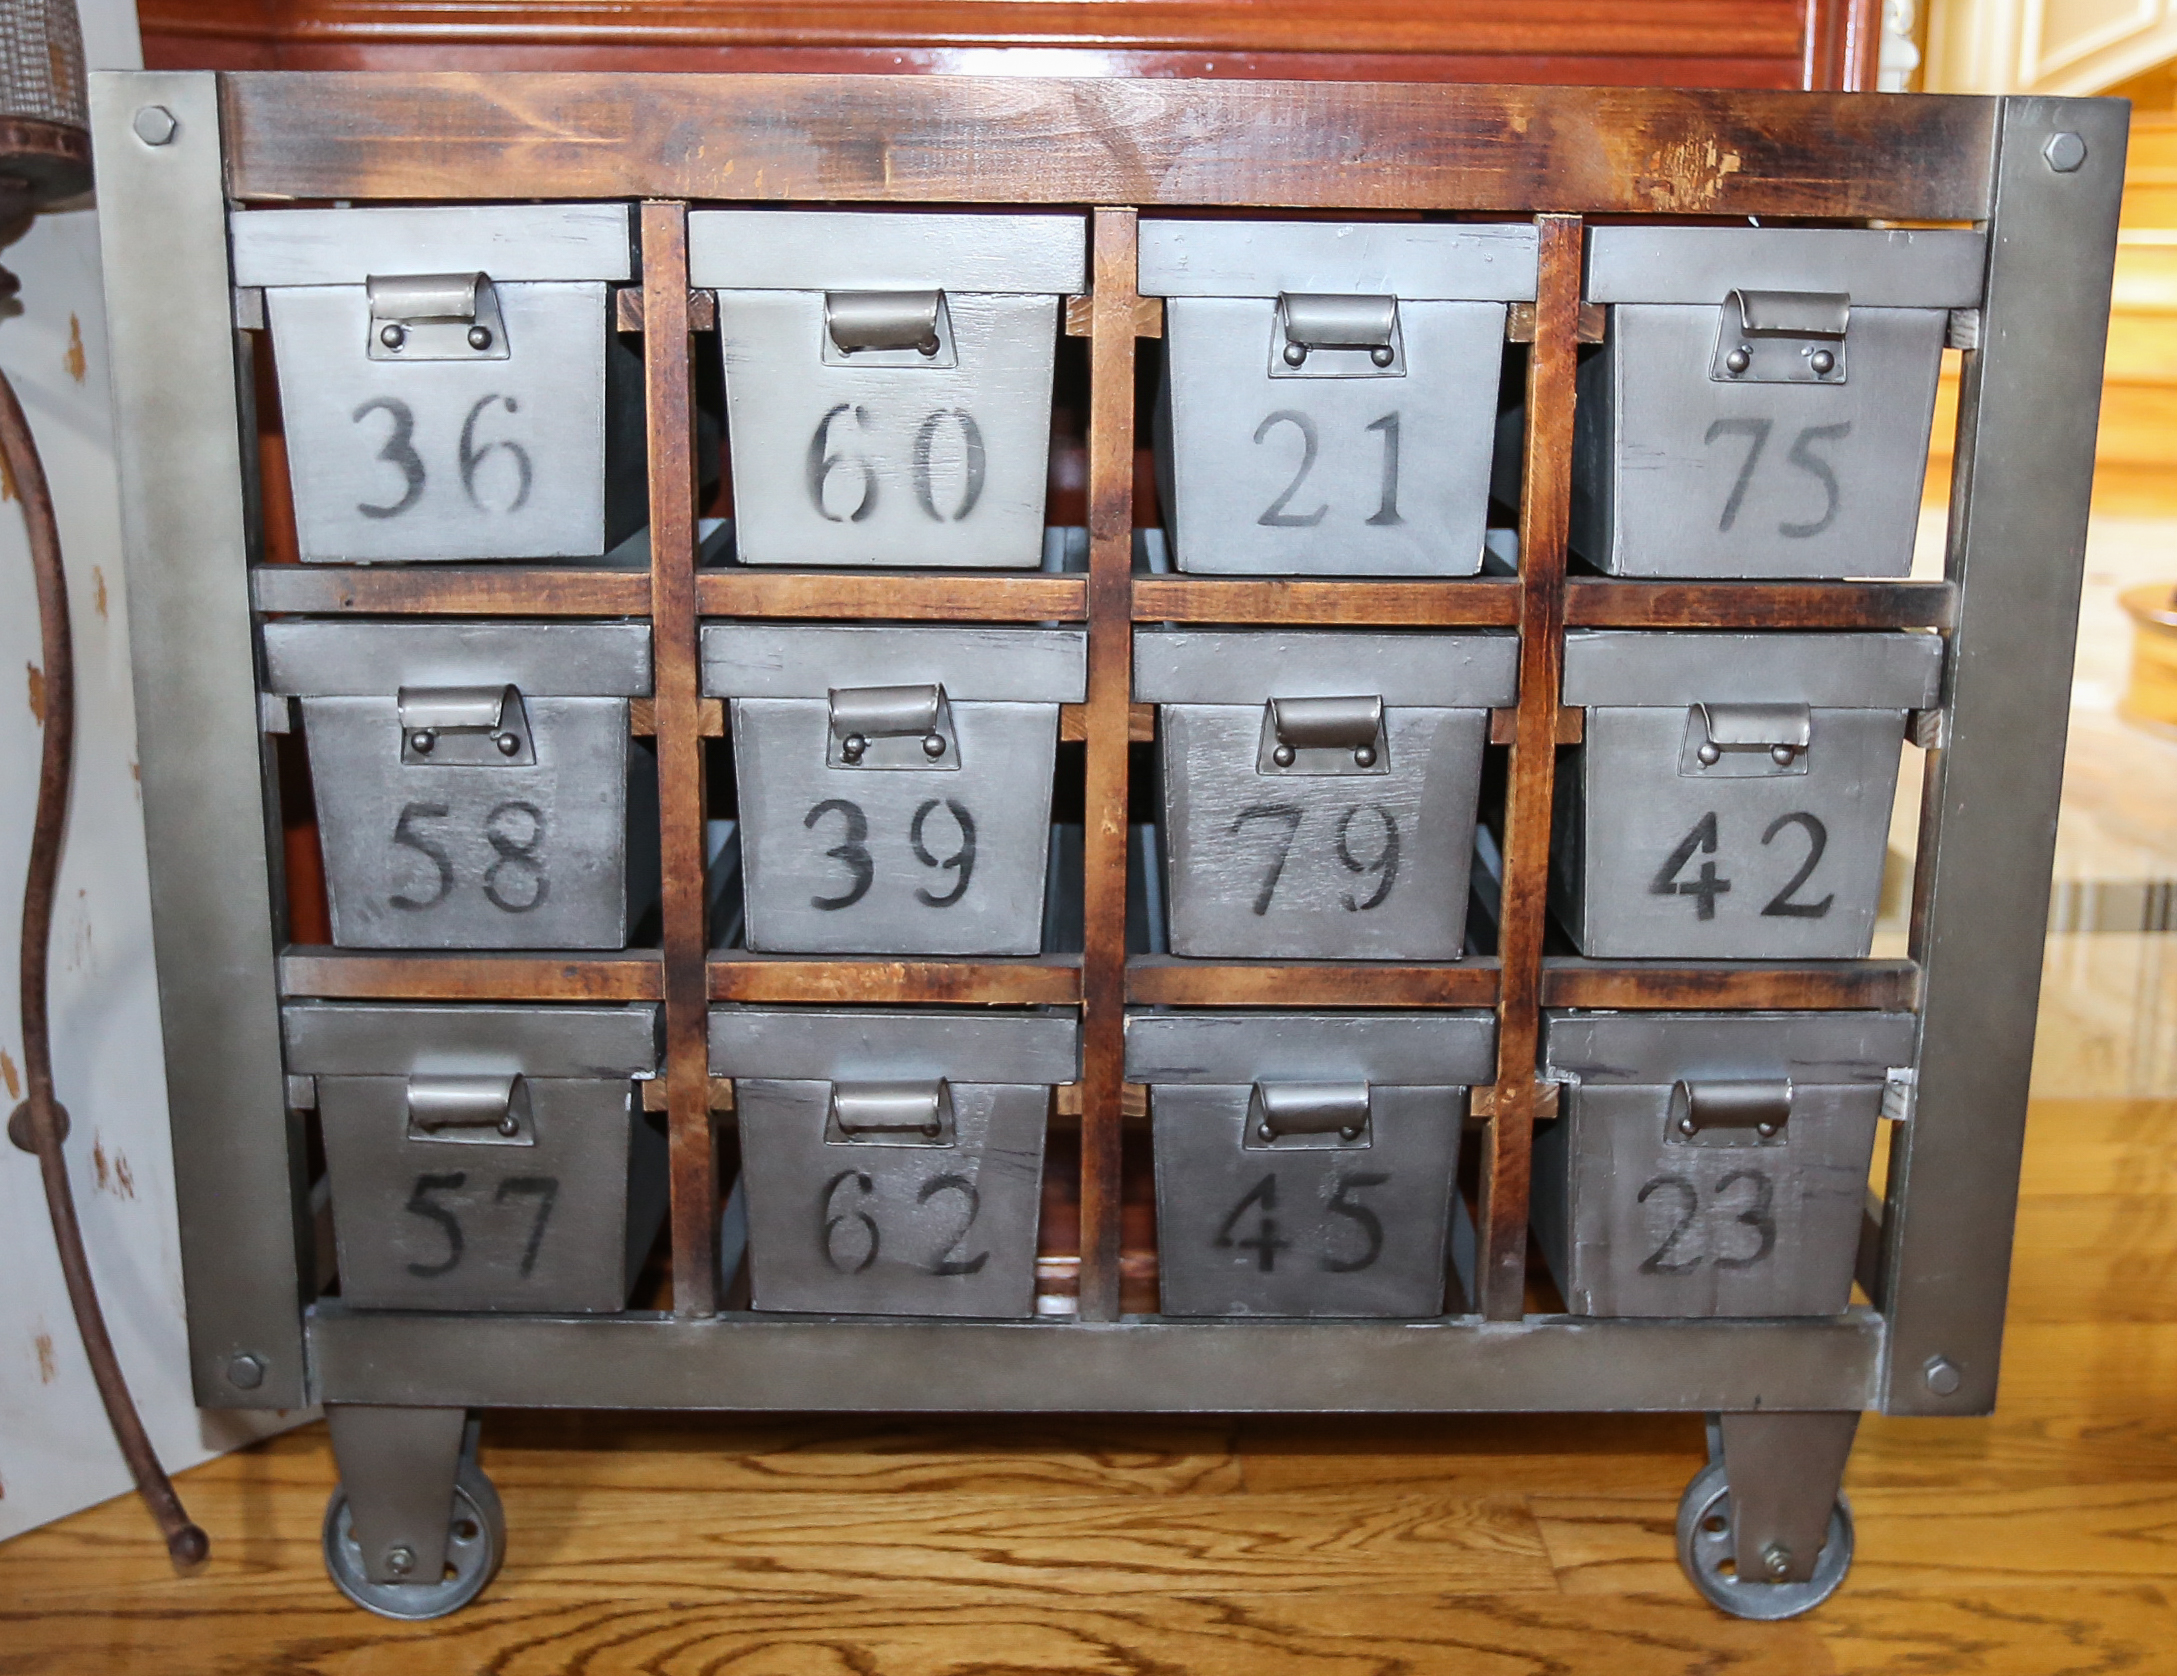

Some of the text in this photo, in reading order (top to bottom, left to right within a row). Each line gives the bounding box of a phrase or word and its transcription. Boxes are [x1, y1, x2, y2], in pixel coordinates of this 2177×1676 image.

[351, 394, 532, 518] 36
[809, 403, 986, 522] 60
[1252, 411, 1406, 526] 21
[1704, 417, 1853, 538] 75
[388, 801, 549, 913] 58
[803, 798, 977, 908] 39
[1232, 804, 1397, 915] 79
[1650, 811, 1835, 919] 42
[405, 1172, 560, 1278] 57
[822, 1169, 990, 1275] 62
[1215, 1173, 1391, 1272] 45
[1637, 1170, 1777, 1272] 23
